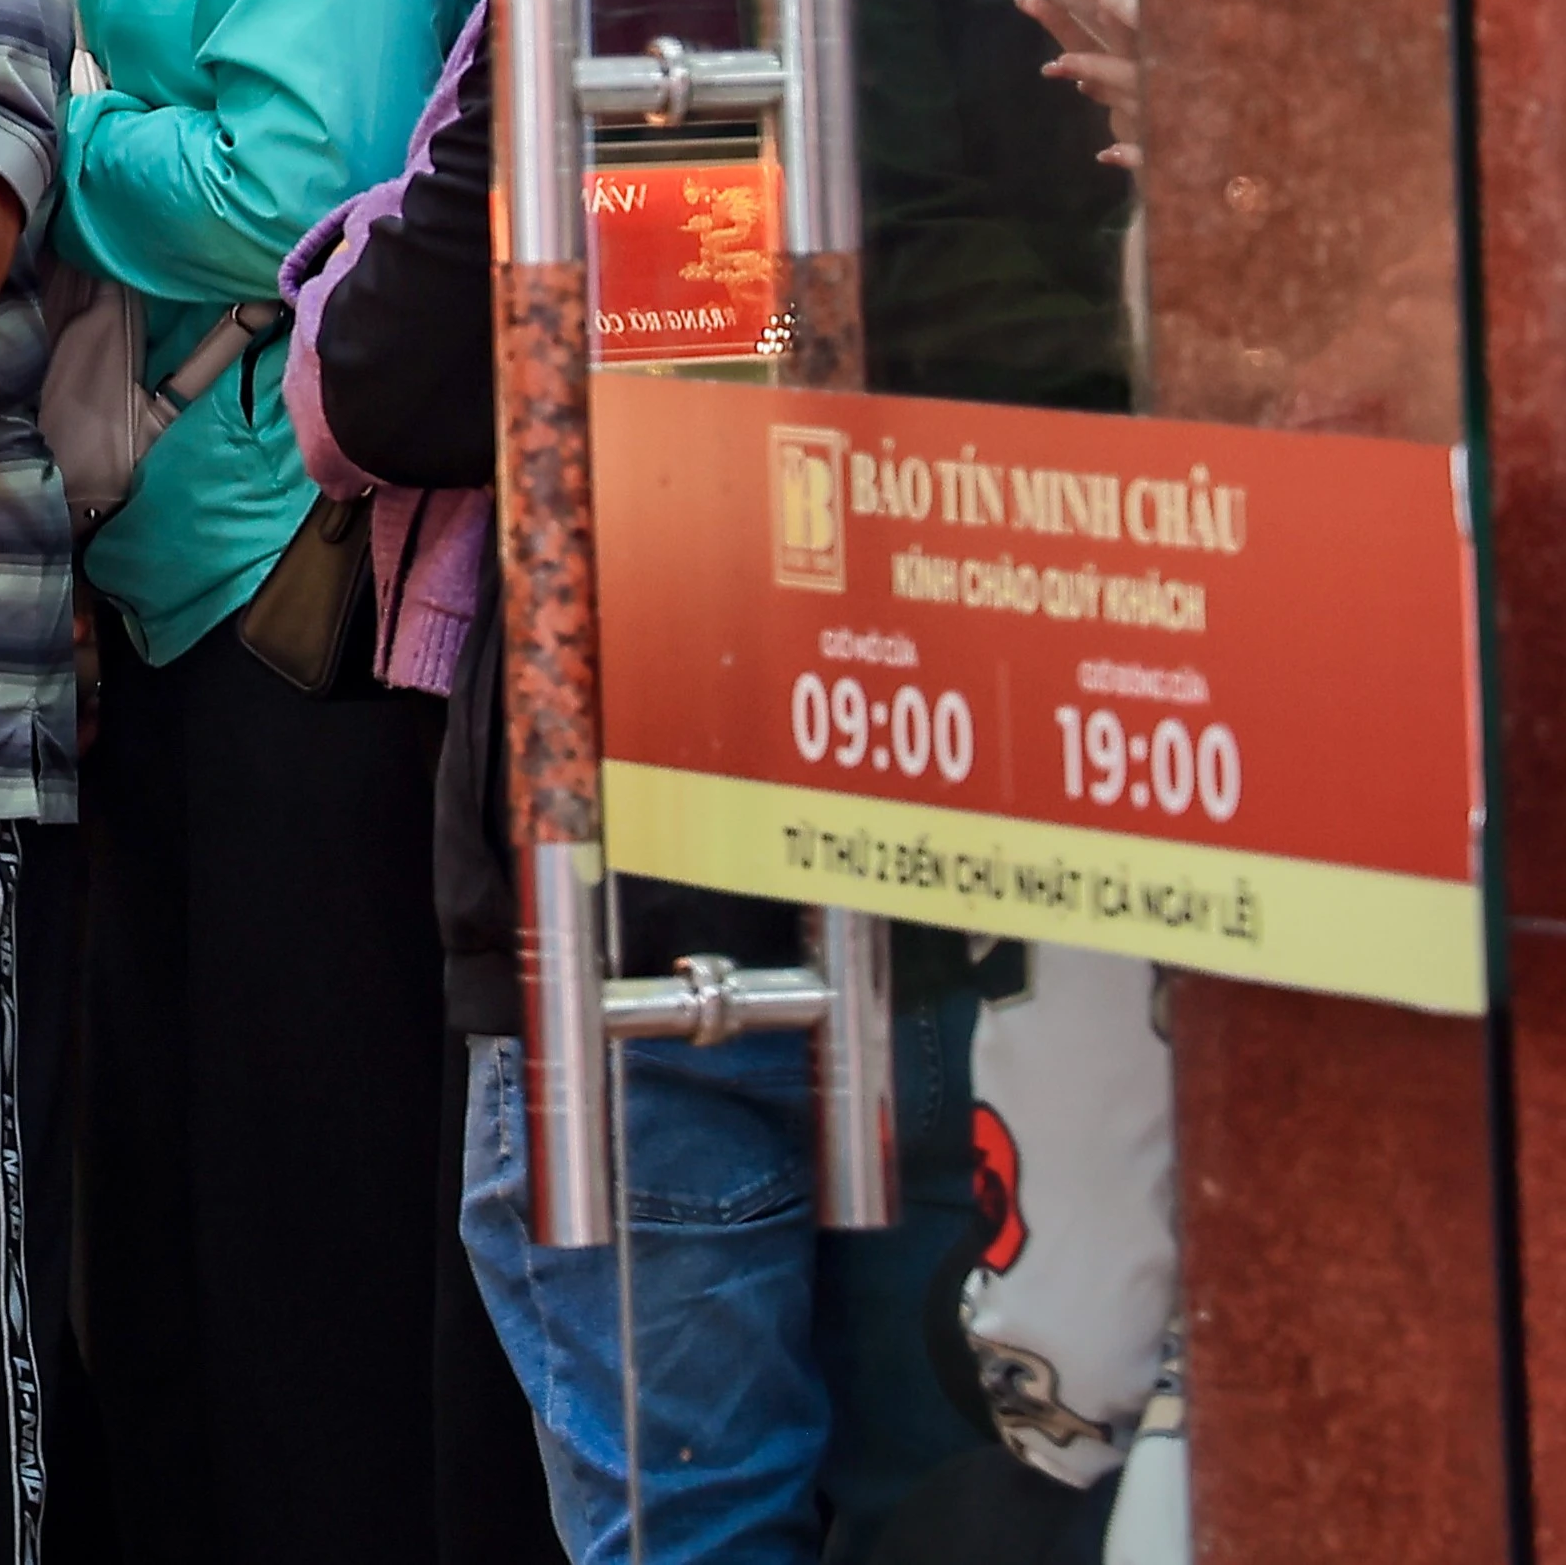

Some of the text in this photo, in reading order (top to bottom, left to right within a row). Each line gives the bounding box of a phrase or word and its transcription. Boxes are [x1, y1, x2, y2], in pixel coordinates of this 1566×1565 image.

[849, 435, 1248, 555] BẢO TÍN MINH CHÂU
[891, 542, 959, 604] KÍNH
[959, 551, 1040, 617] CHÀO
[1102, 566, 1208, 632] KHÁCH
[791, 671, 975, 785] 09:00
[1054, 704, 1243, 823] 19:00
